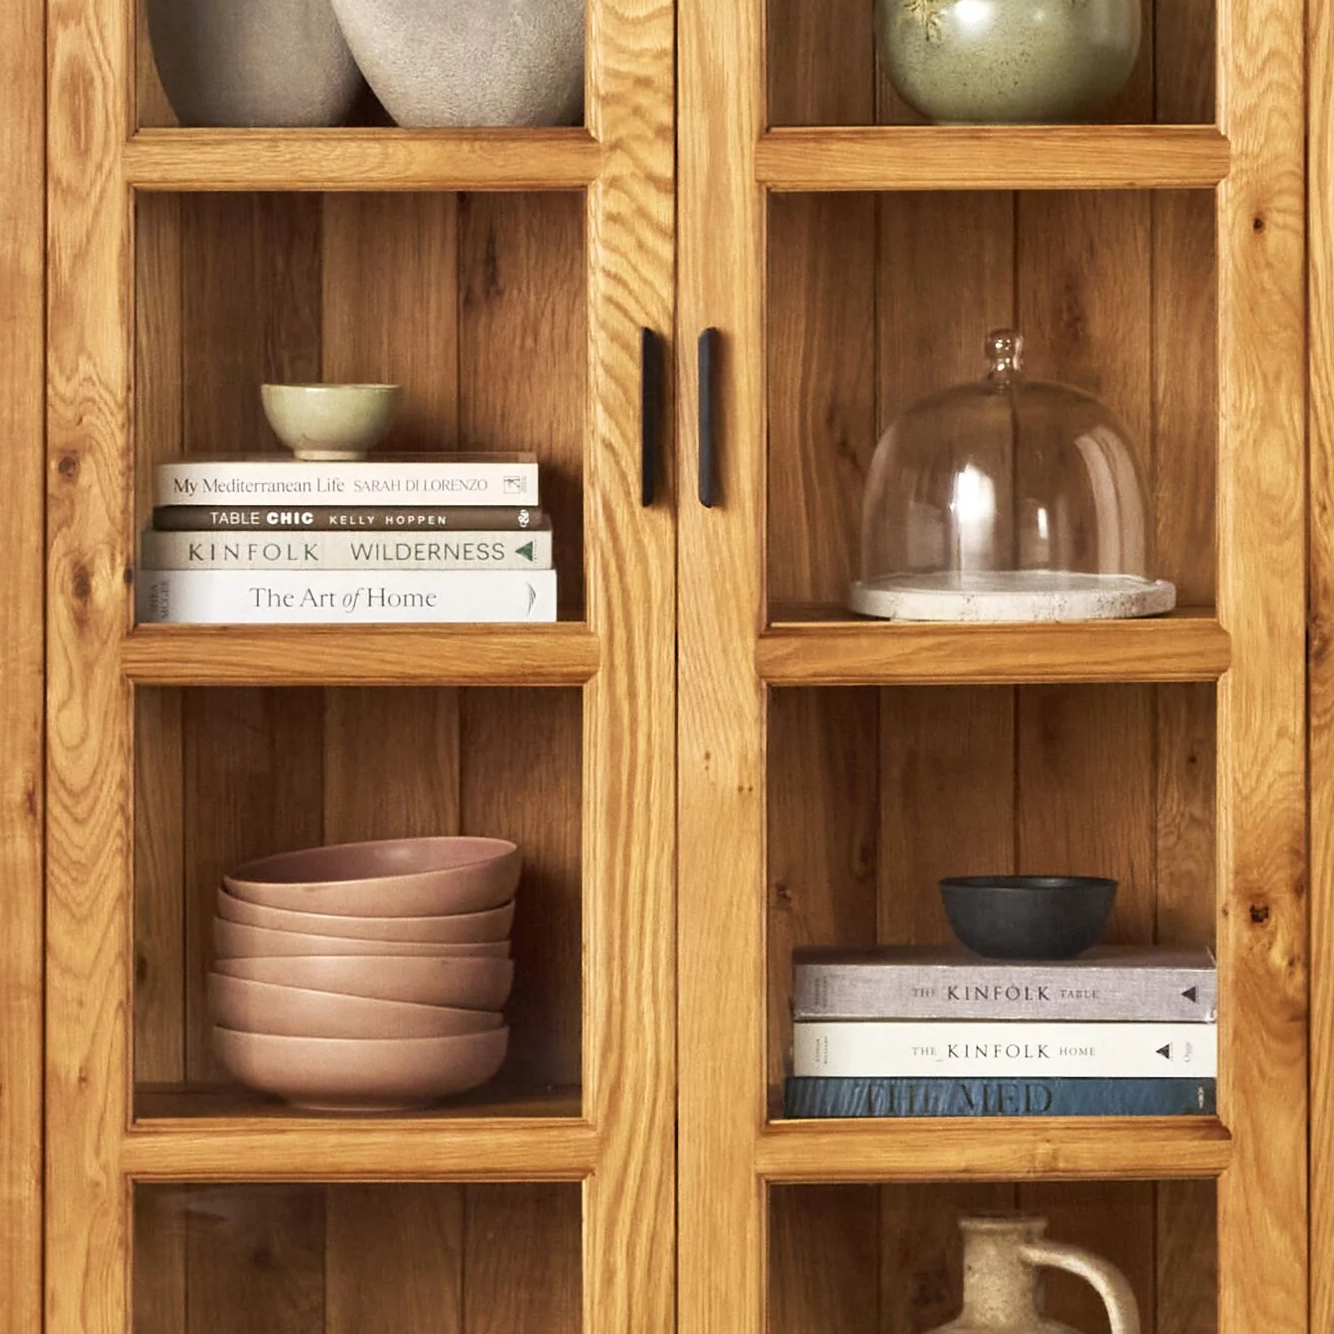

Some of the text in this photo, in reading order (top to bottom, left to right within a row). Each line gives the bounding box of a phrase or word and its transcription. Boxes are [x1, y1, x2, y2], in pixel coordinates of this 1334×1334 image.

[173, 477, 345, 496] My Mediterranean Life
[354, 479, 488, 492] SARAH DI LORENZO
[210, 512, 314, 525] TABLE CHIC
[329, 515, 447, 525] KELLY HOPPEN
[189, 543, 319, 561] KINFOLK
[351, 543, 505, 561] WILDERNESS
[249, 587, 437, 614] The Art of Home
[947, 984, 1050, 1001] KINFOLK
[1060, 989, 1100, 999] TABLE
[912, 1044, 1096, 1058] THE KINFOLK HOME
